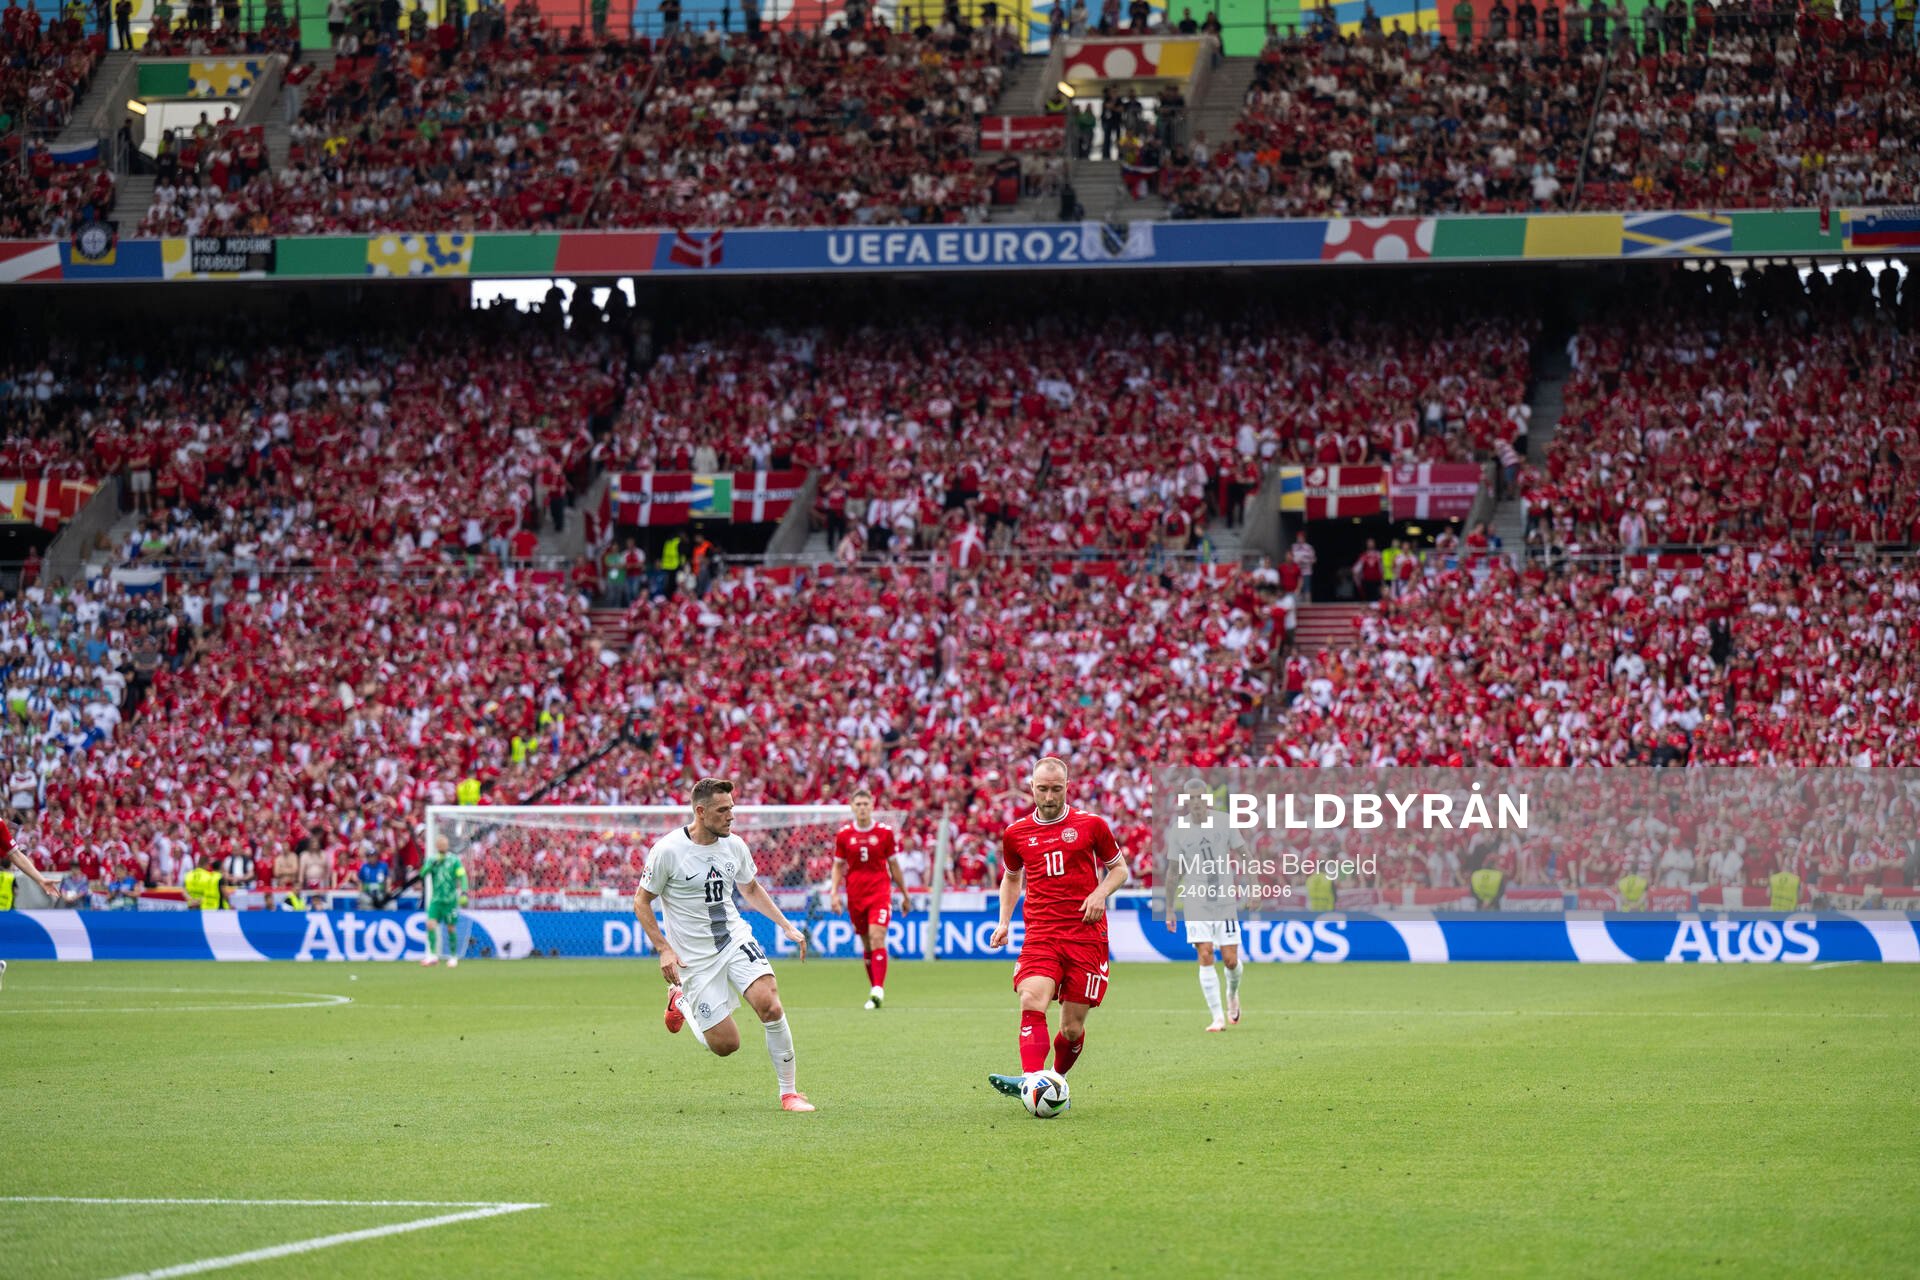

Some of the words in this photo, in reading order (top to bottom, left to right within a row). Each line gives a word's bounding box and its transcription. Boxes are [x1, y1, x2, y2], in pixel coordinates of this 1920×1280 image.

[860, 846, 868, 862] 3
[1044, 851, 1065, 877] 10
[704, 879, 723, 902] 10
[878, 908, 887, 924] 3
[1225, 918, 1236, 933] 11
[740, 942, 766, 962] 10
[1084, 972, 1101, 998] 10
